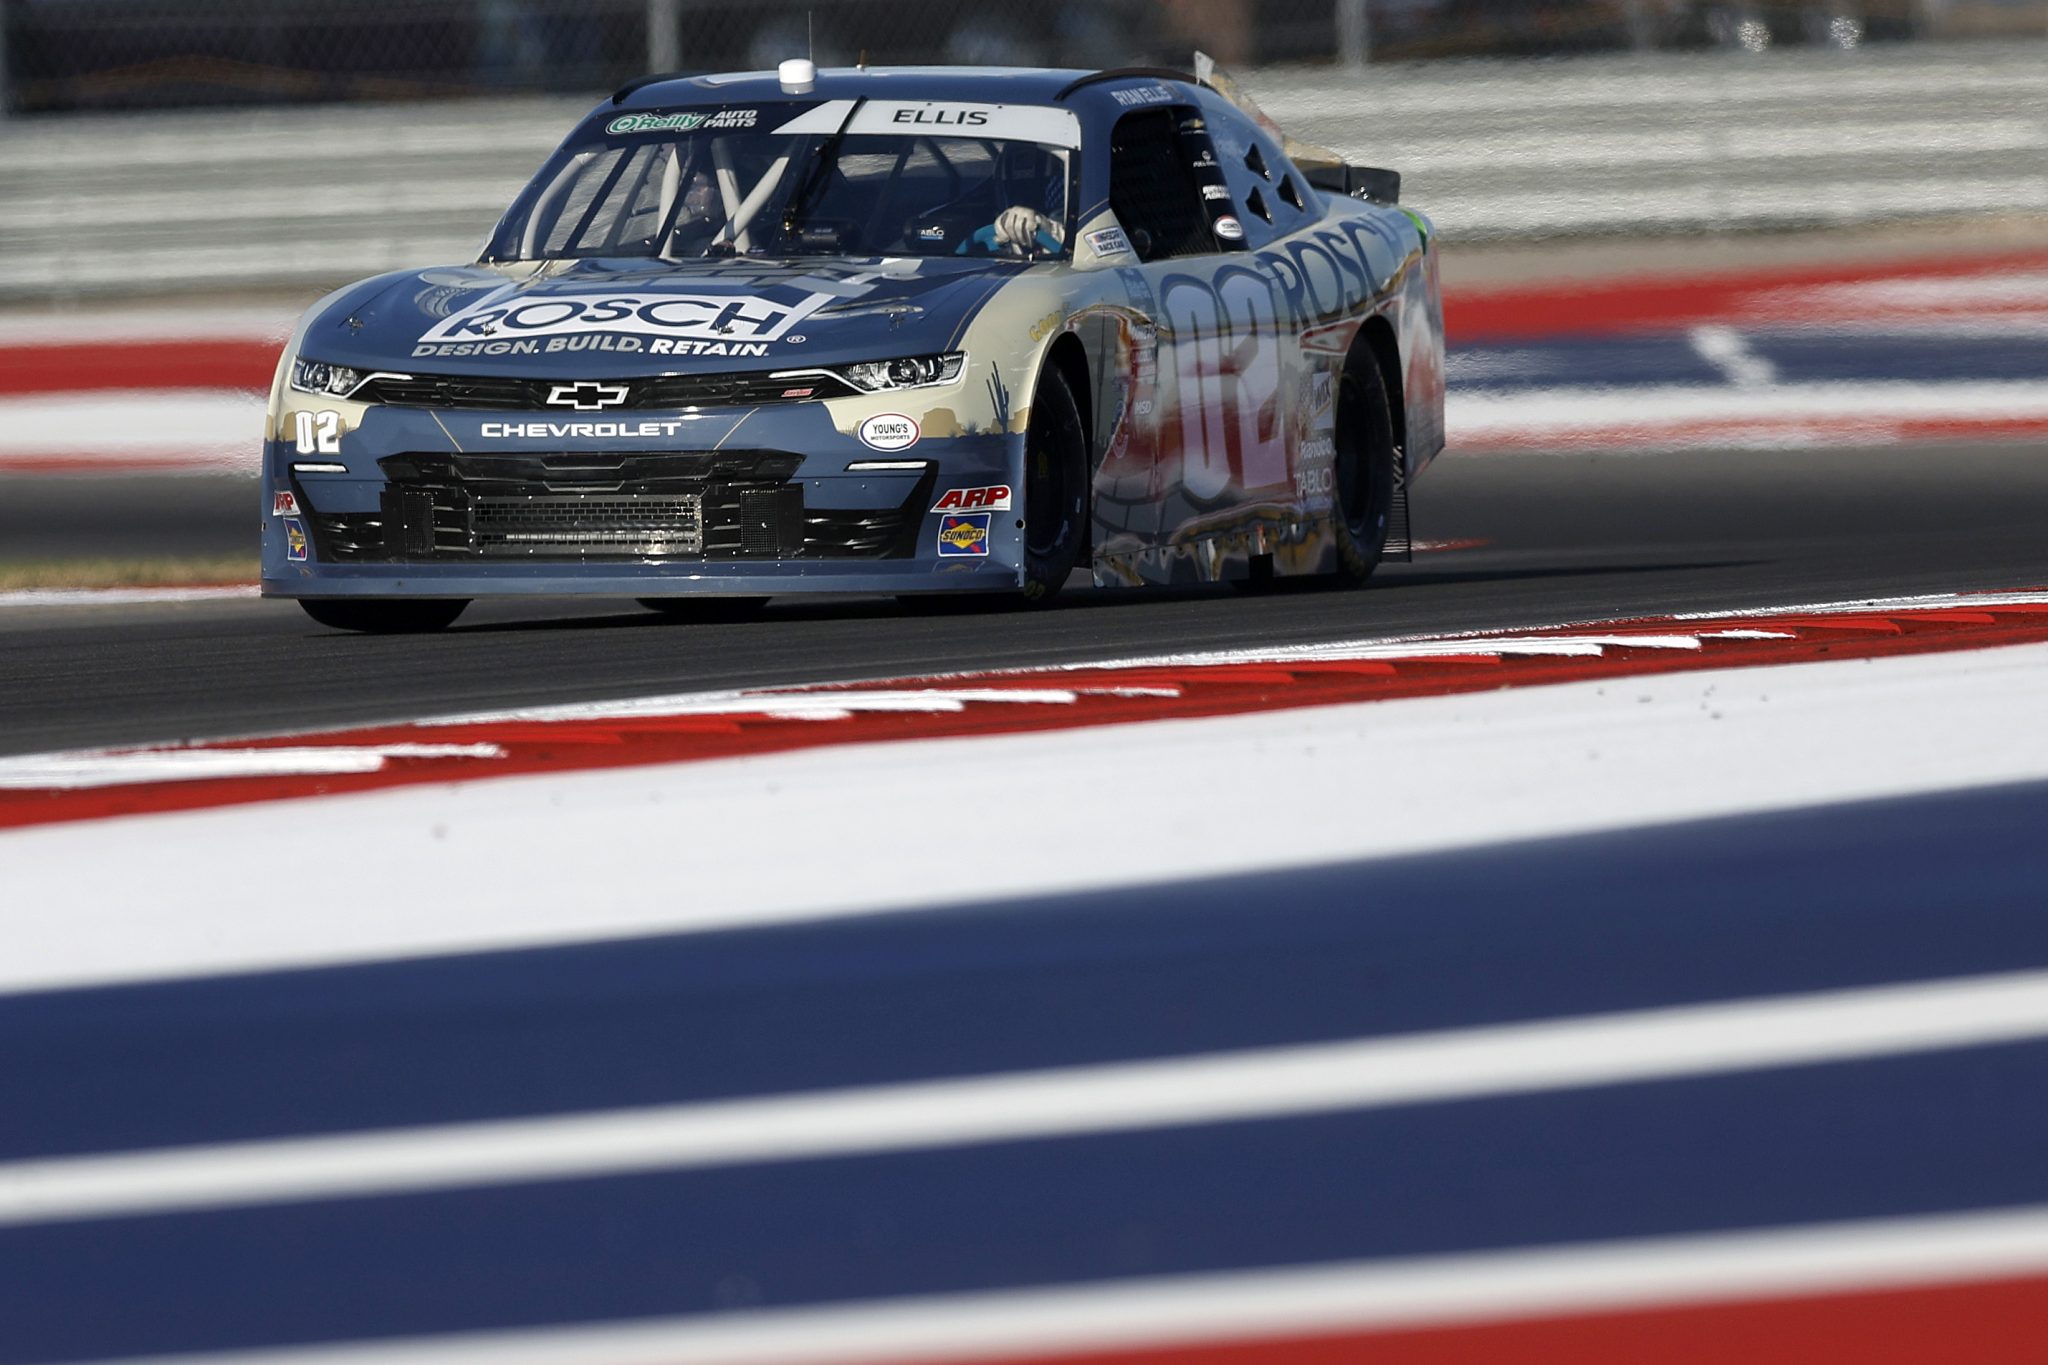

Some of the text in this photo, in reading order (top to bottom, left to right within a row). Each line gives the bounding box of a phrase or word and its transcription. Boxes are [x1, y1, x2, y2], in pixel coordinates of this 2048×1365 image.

[606, 112, 704, 133] O'Reilly
[703, 118, 757, 128] PARTS
[714, 110, 757, 119] AUTO
[892, 109, 988, 125] ELLIS
[441, 299, 788, 338] ROSCH
[411, 341, 539, 357] DESIGN.
[544, 335, 644, 353] BUILD.
[294, 409, 341, 454] 02
[481, 423, 681, 438] CHEVROLET
[872, 423, 909, 434] YOUNG'S
[1293, 467, 1333, 497] TABLO
[936, 486, 1010, 509] ARP
[941, 529, 985, 541] SUNOCO
